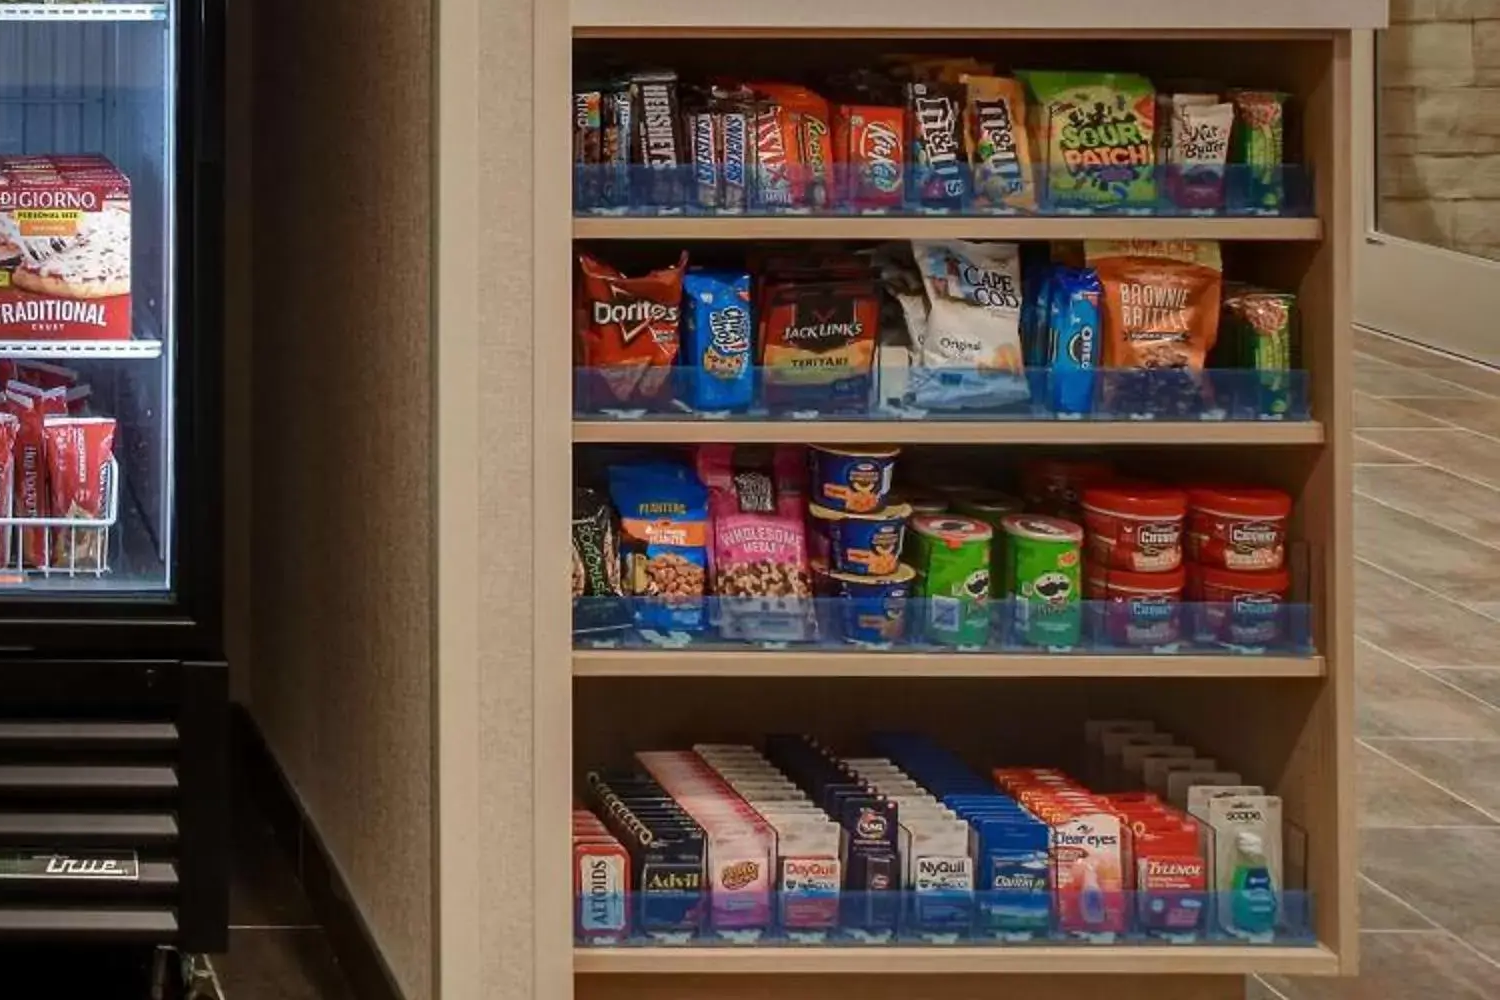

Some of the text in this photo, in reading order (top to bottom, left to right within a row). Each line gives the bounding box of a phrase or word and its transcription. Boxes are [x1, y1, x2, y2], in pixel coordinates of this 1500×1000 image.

[1061, 123, 1142, 148] SOUR
[1063, 142, 1150, 170] PATCH
[963, 265, 1014, 292] CAPE
[974, 288, 1019, 308] COD
[1120, 283, 1191, 310] BROWNIE
[593, 300, 678, 324] Doritos
[783, 325, 819, 340] JACK
[720, 526, 803, 546] WHOLESOME
[1086, 834, 1117, 848] eyes
[920, 861, 965, 876] NyQuil
[1148, 861, 1202, 876] TYLENOL
[648, 872, 699, 889] Advil
[591, 859, 607, 924] ALTOIDS
